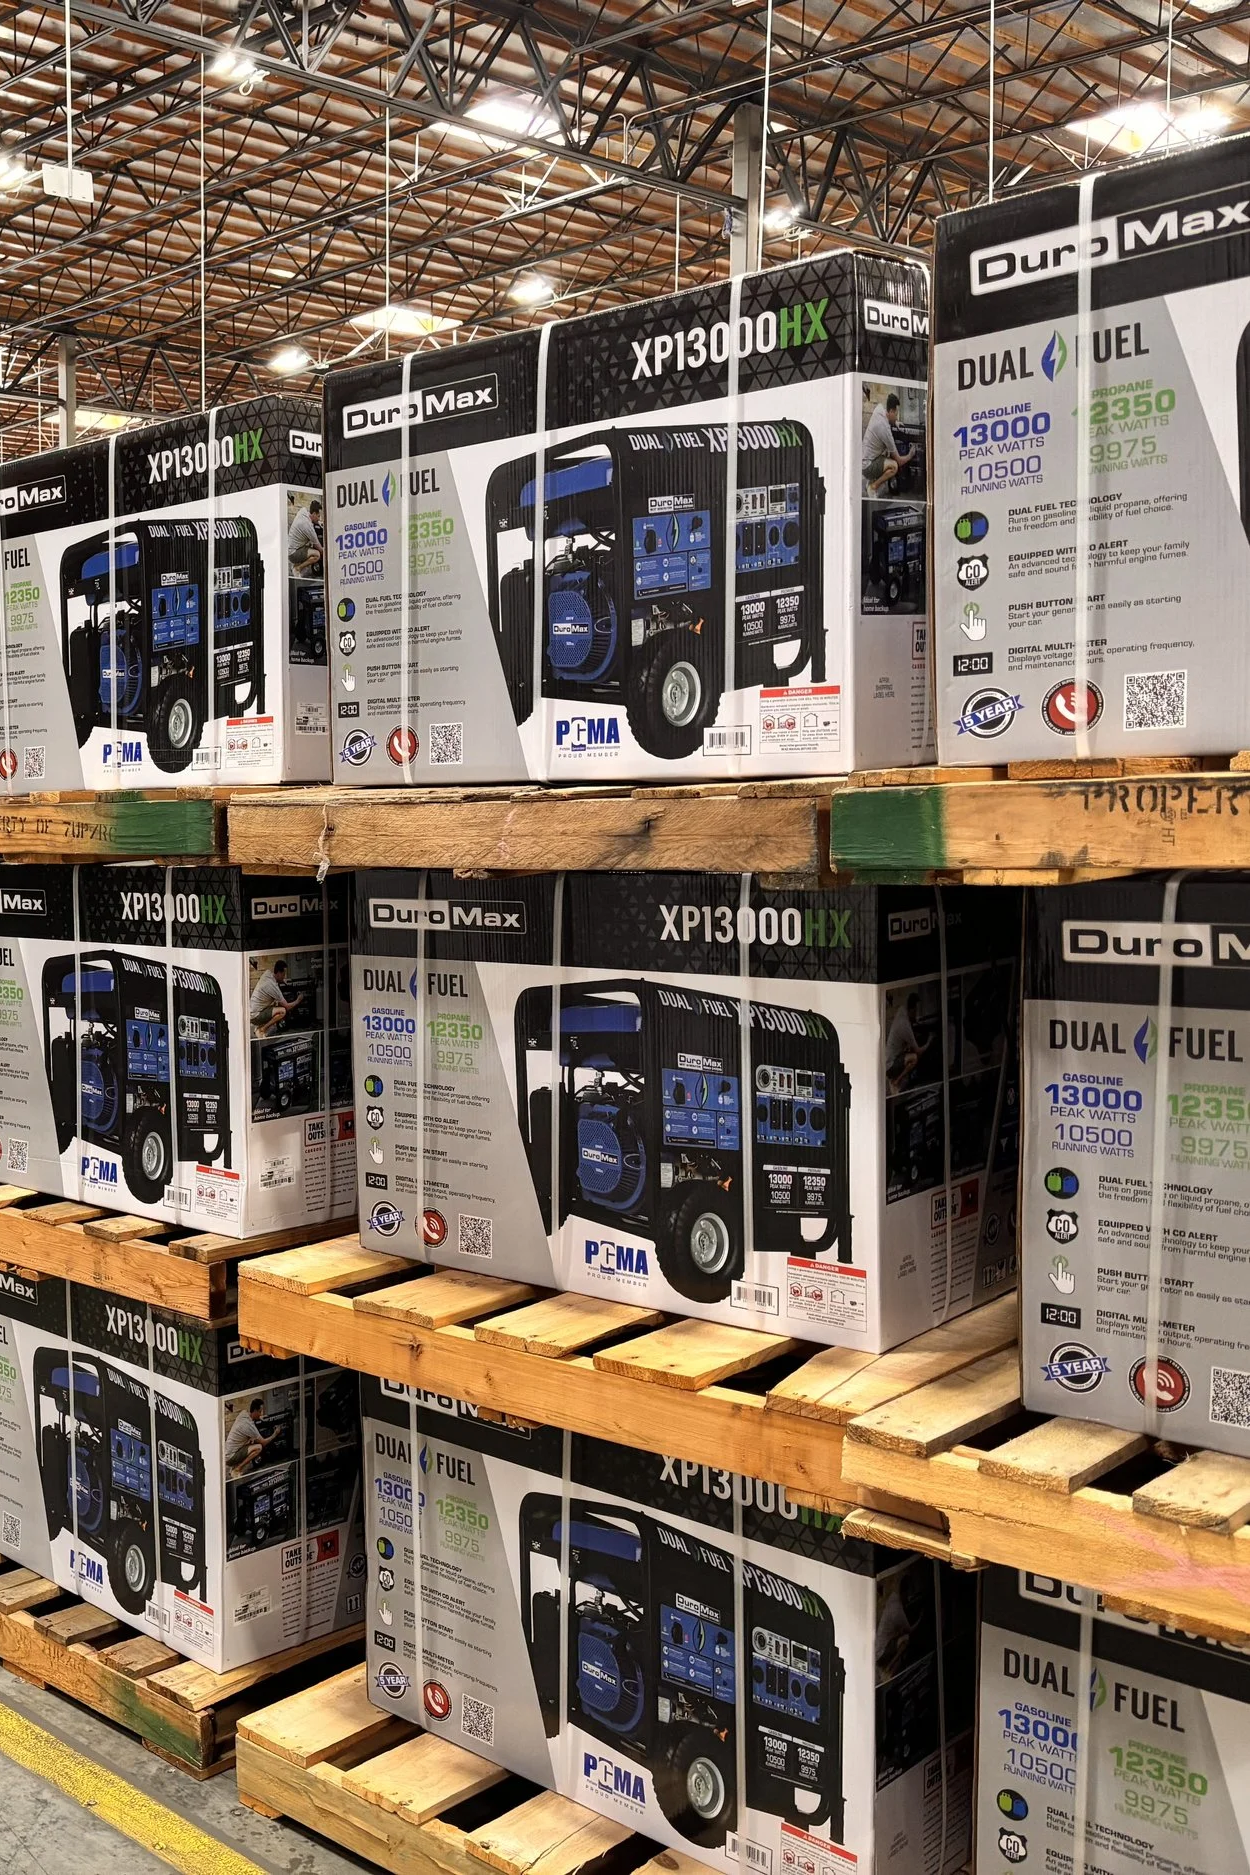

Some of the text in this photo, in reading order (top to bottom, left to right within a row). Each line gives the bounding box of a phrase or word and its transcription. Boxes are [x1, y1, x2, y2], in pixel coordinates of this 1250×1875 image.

[631, 298, 829, 381] XP13000HX
[957, 345, 1034, 391] DUAL
[347, 386, 493, 431] DuroMax
[970, 402, 1032, 422] GASOLINE
[953, 411, 1051, 448] 13000
[1118, 414, 1169, 435] WATTS
[628, 432, 705, 452] DUAL FUEL
[959, 436, 1045, 460] PEAK WATTS
[147, 428, 265, 484] XP13000HX
[964, 454, 1042, 485] 10500
[336, 479, 379, 509] DUAL
[960, 473, 1044, 496] RUNNING WATTS
[650, 496, 694, 509] DuroMax
[1008, 503, 1058, 517] DUAL FUEL
[148, 523, 194, 539] DUAL FUEL
[344, 520, 378, 532] GASOLINE
[1023, 521, 1058, 532] freedom
[335, 528, 388, 551] 13000
[4, 547, 31, 570] FUEL
[338, 546, 385, 560] PEAK WATTS
[1008, 539, 1129, 562] EQUIPPED ALERT
[1021, 540, 1190, 569] advanced family
[340, 560, 384, 577] 10500
[965, 564, 981, 579] CO
[1093, 558, 1127, 569] harmful
[161, 572, 189, 584] DuroMax
[363, 573, 385, 584] WATTS
[740, 601, 766, 616] 13000
[775, 596, 799, 608] 12350
[1008, 597, 1073, 612] PUSH BUTTON
[10, 612, 35, 625] 9975
[553, 623, 589, 635] DuroMax
[1008, 645, 1043, 655] DIGITAL
[1042, 643, 1148, 662] voltage operating
[957, 657, 989, 671] 12:00
[787, 687, 813, 696] DANGER
[963, 699, 1017, 728] 5 YEAR
[351, 736, 372, 756] YEAR
[120, 892, 228, 925] XP13000HX
[373, 904, 521, 928] DuroMax
[659, 903, 851, 949] XP13000HX
[363, 968, 469, 998] DUAL FUEL
[371, 1007, 405, 1017] GASOLINE
[659, 989, 733, 1018] DUAL FUEL
[362, 1015, 416, 1033] 13000
[426, 1020, 483, 1041] 12350
[365, 1030, 413, 1043] PEAK WATTS
[1049, 1018, 1244, 1063] DUAL FUEL
[368, 1043, 411, 1059] 10500
[436, 1051, 473, 1067] 9975
[678, 1052, 723, 1070] DuroMax
[1062, 1072, 1124, 1087] GASOLINE
[1183, 1083, 1247, 1096] PROPANE
[1044, 1083, 1143, 1112] 13000
[1050, 1106, 1137, 1124] PEAK WATTS
[308, 1121, 324, 1132] TAKE
[1054, 1123, 1133, 1147] 10500
[583, 1149, 618, 1164] DuroMax
[1051, 1141, 1135, 1158] RUNNING WATTS
[1180, 1135, 1249, 1159] 9975
[767, 1172, 793, 1186] 13000
[802, 1175, 827, 1187] 12350
[380, 1211, 401, 1224] YEAR
[1054, 1218, 1071, 1233] CO
[1098, 1219, 1218, 1243] EQUIPPED ALERT
[816, 1261, 839, 1272] DANGER
[1097, 1267, 1195, 1289] PUSH START
[1046, 1307, 1077, 1325] 12:00
[105, 1304, 203, 1366] XP13000HX
[1051, 1357, 1102, 1377] 5 YEAR
[436, 1452, 476, 1487] FUEL
[435, 1498, 490, 1531] 12350
[444, 1529, 480, 1554] 9975
[656, 1525, 732, 1575] DUAL FUEL
[386, 1675, 407, 1686] YEAR
[1003, 1647, 1186, 1734] DUAL FUEL
[1014, 1701, 1072, 1728] GASOLINE
[763, 1736, 787, 1754] 13000
[1002, 1730, 1035, 1750] PEAK
[1003, 1763, 1047, 1787] RUNNING
[1108, 1745, 1208, 1797] 12350
[1124, 1789, 1190, 1826] 9975
